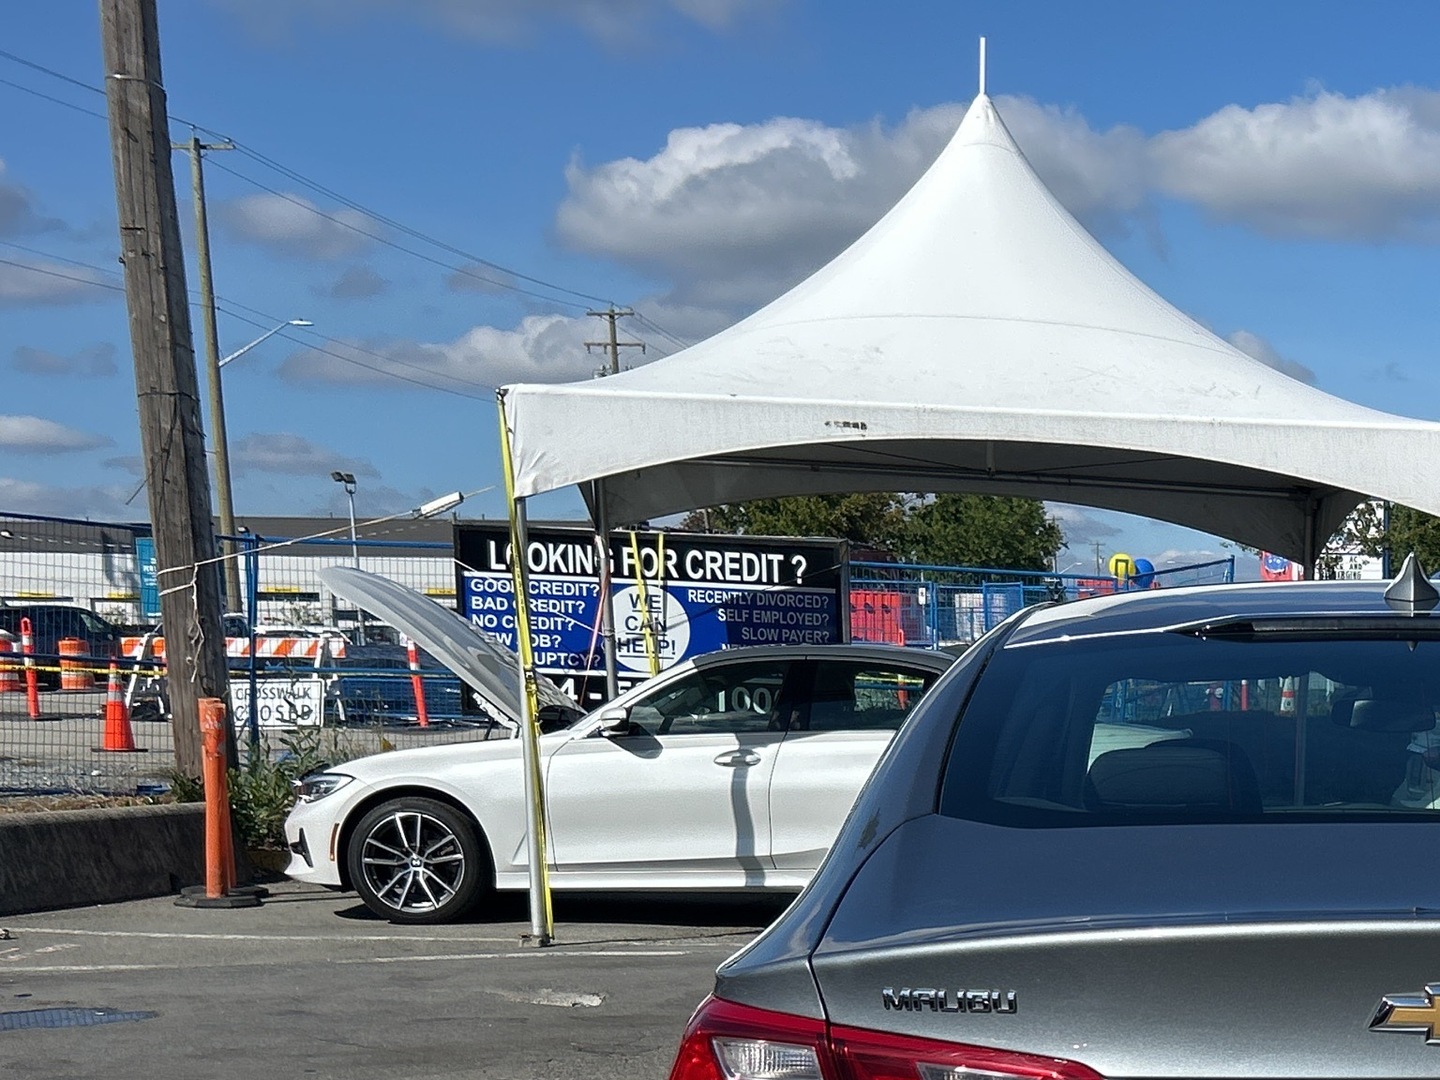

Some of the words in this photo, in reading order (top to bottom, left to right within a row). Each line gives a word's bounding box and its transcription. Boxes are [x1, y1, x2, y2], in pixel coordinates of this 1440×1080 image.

[622, 546, 679, 578] FOR
[685, 549, 784, 583] CREDIT
[471, 578, 515, 593] GOO
[529, 582, 600, 597] CREDIT?
[472, 596, 508, 610] BAD
[513, 599, 586, 614] REDIT?
[629, 593, 661, 609] WE
[688, 589, 753, 605] RECENTLY
[756, 593, 829, 608] DIVORCED?
[472, 614, 497, 628] NO
[502, 615, 575, 631] CEDIT?
[718, 608, 749, 621] SELF
[753, 610, 829, 625] EMPLOYED?
[742, 627, 779, 641] SLOW
[782, 629, 829, 643] PAYER?
[236, 687, 311, 700] CRSSWALK
[234, 704, 312, 721] COSED
[882, 986, 1018, 1014] MALIBU
